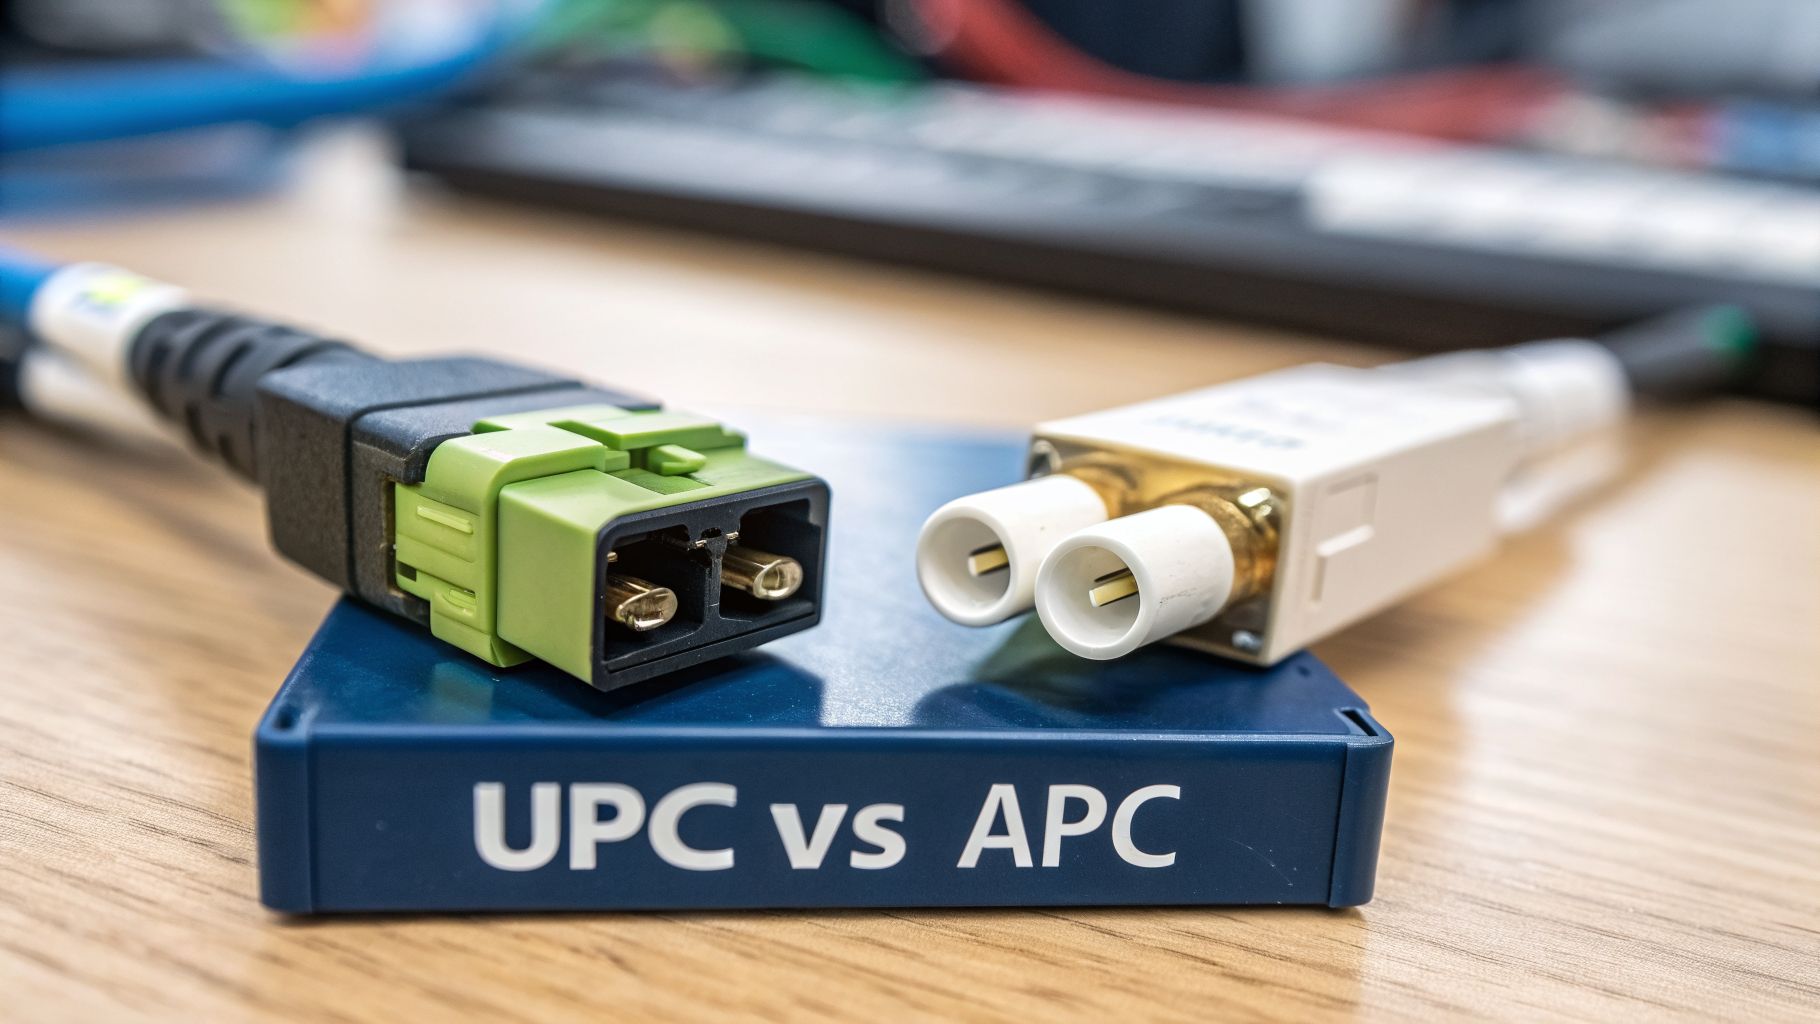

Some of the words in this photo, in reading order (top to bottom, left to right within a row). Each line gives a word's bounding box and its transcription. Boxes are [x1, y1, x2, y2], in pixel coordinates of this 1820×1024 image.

[473, 782, 738, 871] UPC
[770, 803, 907, 870] vs
[956, 783, 1181, 868] APC
